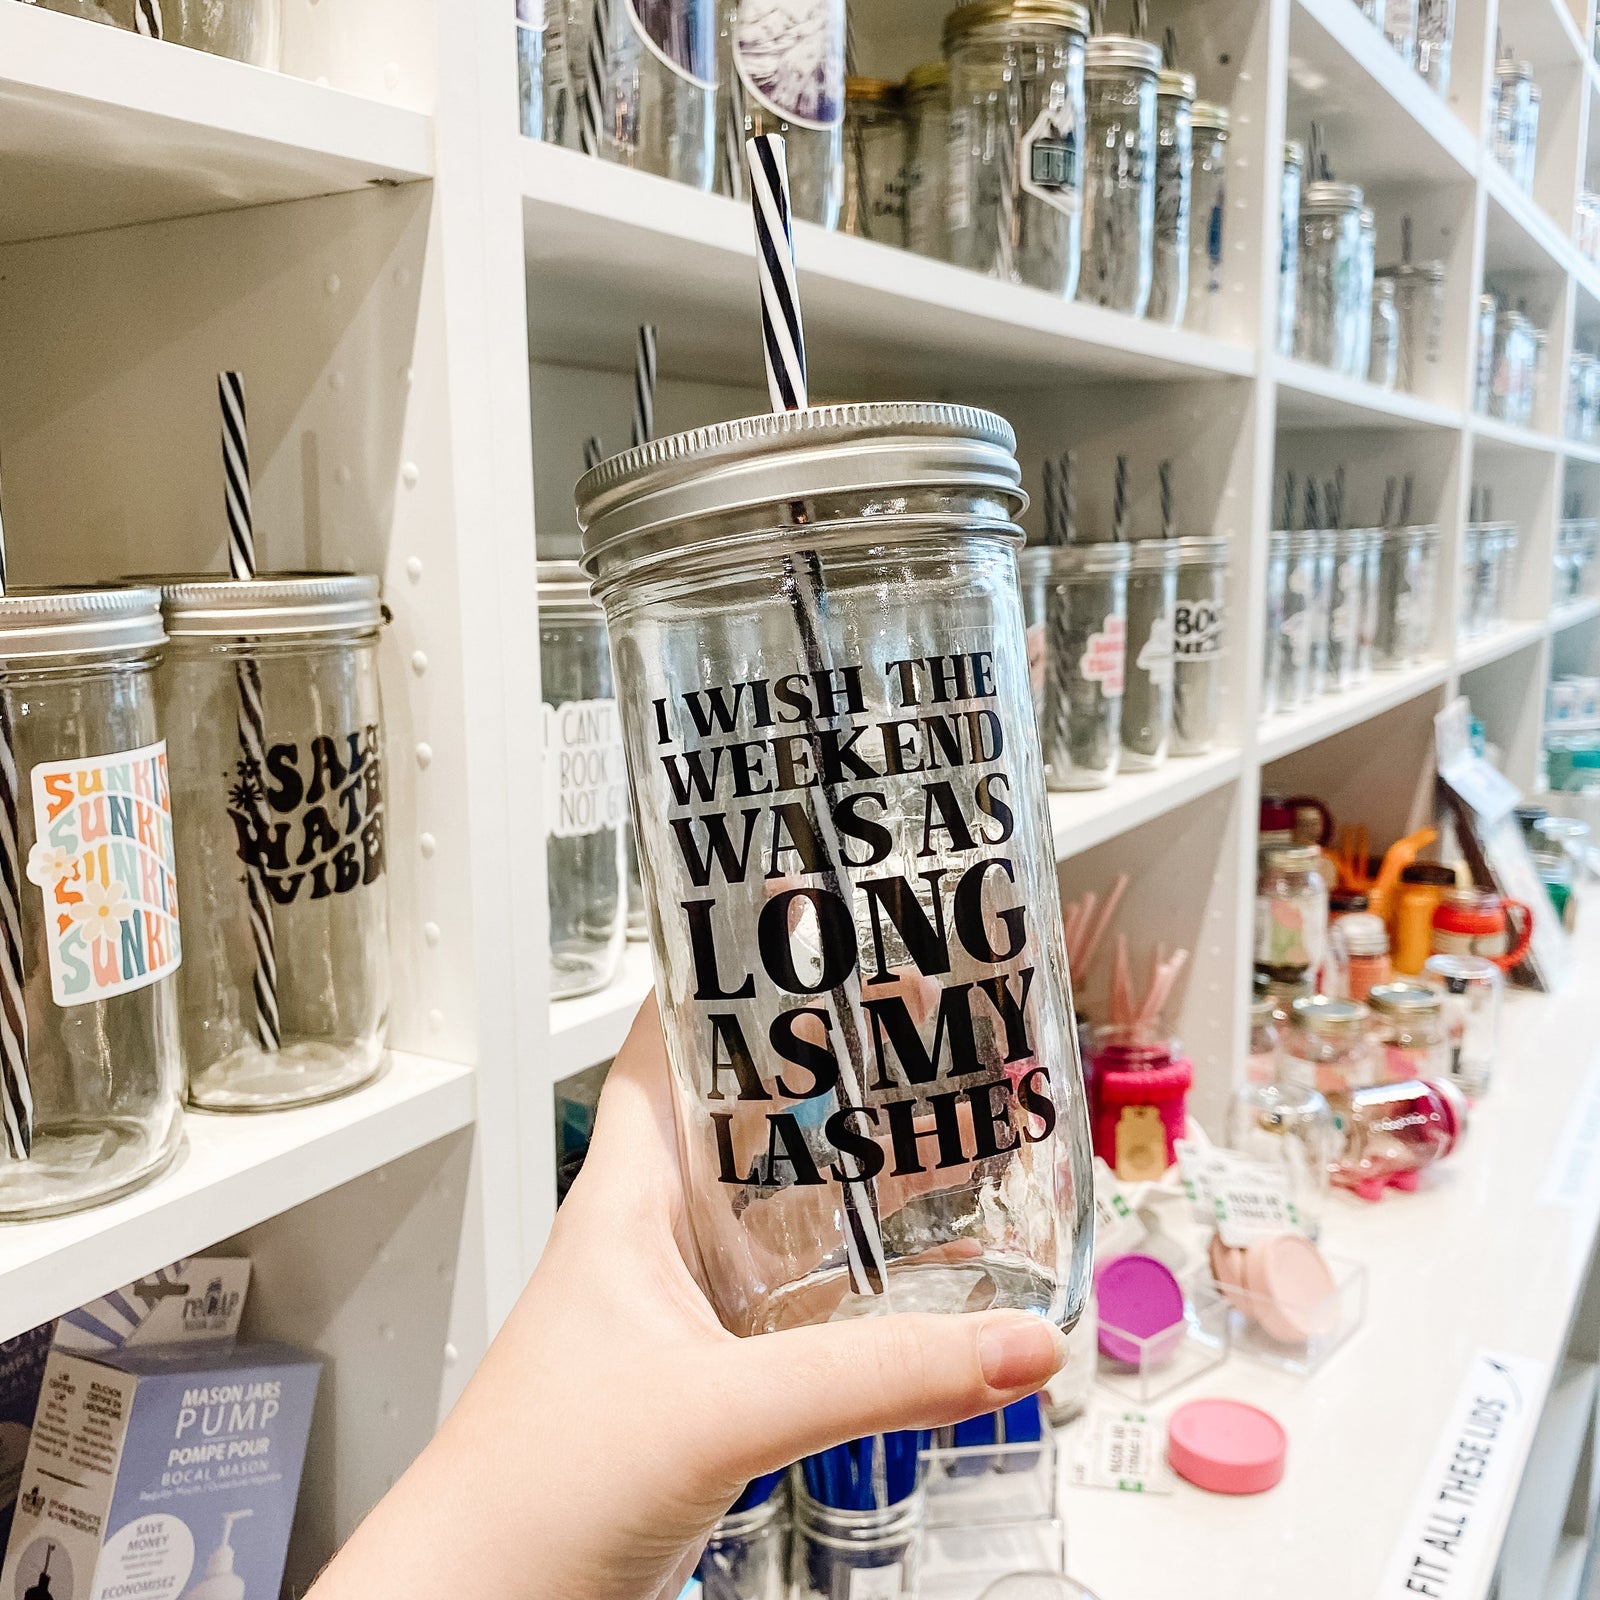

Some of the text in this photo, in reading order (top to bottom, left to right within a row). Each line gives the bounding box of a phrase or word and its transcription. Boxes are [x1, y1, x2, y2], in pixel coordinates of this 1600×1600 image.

[652, 651, 997, 745] I WISH THE
[659, 709, 1004, 806] WEEKEND
[670, 772, 1015, 887] WAS AS
[680, 857, 1028, 1001] LONG
[706, 967, 1036, 1101] AS MY
[709, 1066, 1057, 1187] LASHES
[175, 1400, 280, 1440] PUMP
[181, 1381, 282, 1408] MASON JARS
[161, 1468, 211, 1487] BOCAL
[167, 1437, 271, 1467] POMPE POUR
[1406, 1397, 1508, 1599] FIT ALL THESE LIDS
